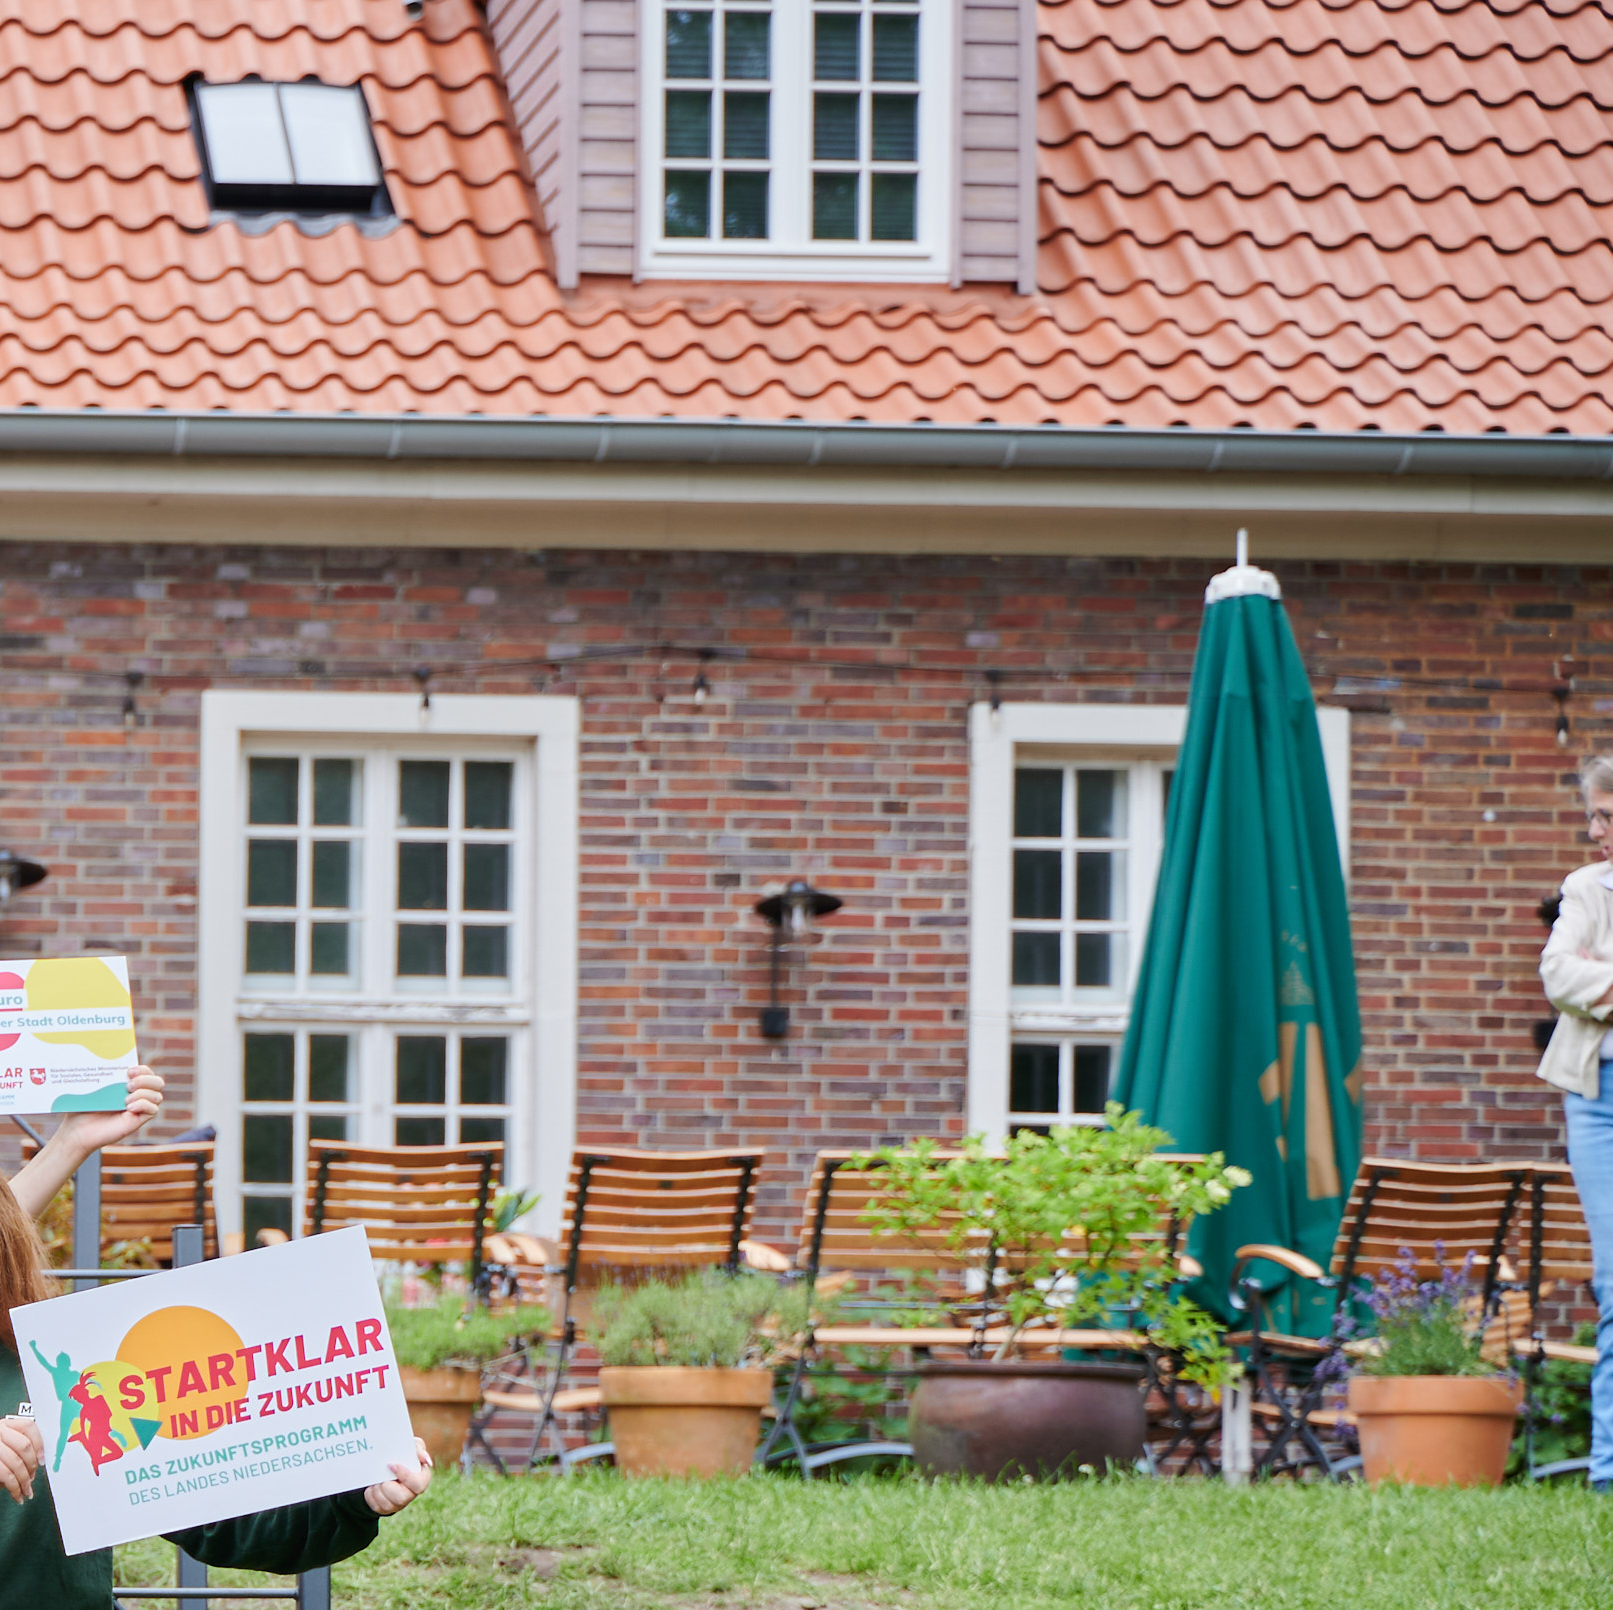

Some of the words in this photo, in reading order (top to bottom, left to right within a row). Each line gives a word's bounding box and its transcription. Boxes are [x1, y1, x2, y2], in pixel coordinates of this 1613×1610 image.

[16, 1016, 54, 1027] Stadt
[56, 1014, 126, 1026] Oldenburg
[118, 1318, 384, 1410] STARTKLAR
[170, 1409, 199, 1438] IN
[205, 1397, 251, 1430] DIE
[257, 1364, 389, 1417] ZUKUNFT
[124, 1463, 162, 1485] DAS
[164, 1415, 367, 1475] ZUKUNFTSPROGRAMM
[128, 1486, 161, 1506] DES
[163, 1470, 230, 1497] LANDES
[232, 1437, 373, 1481] NIEDERSACHSEN.
